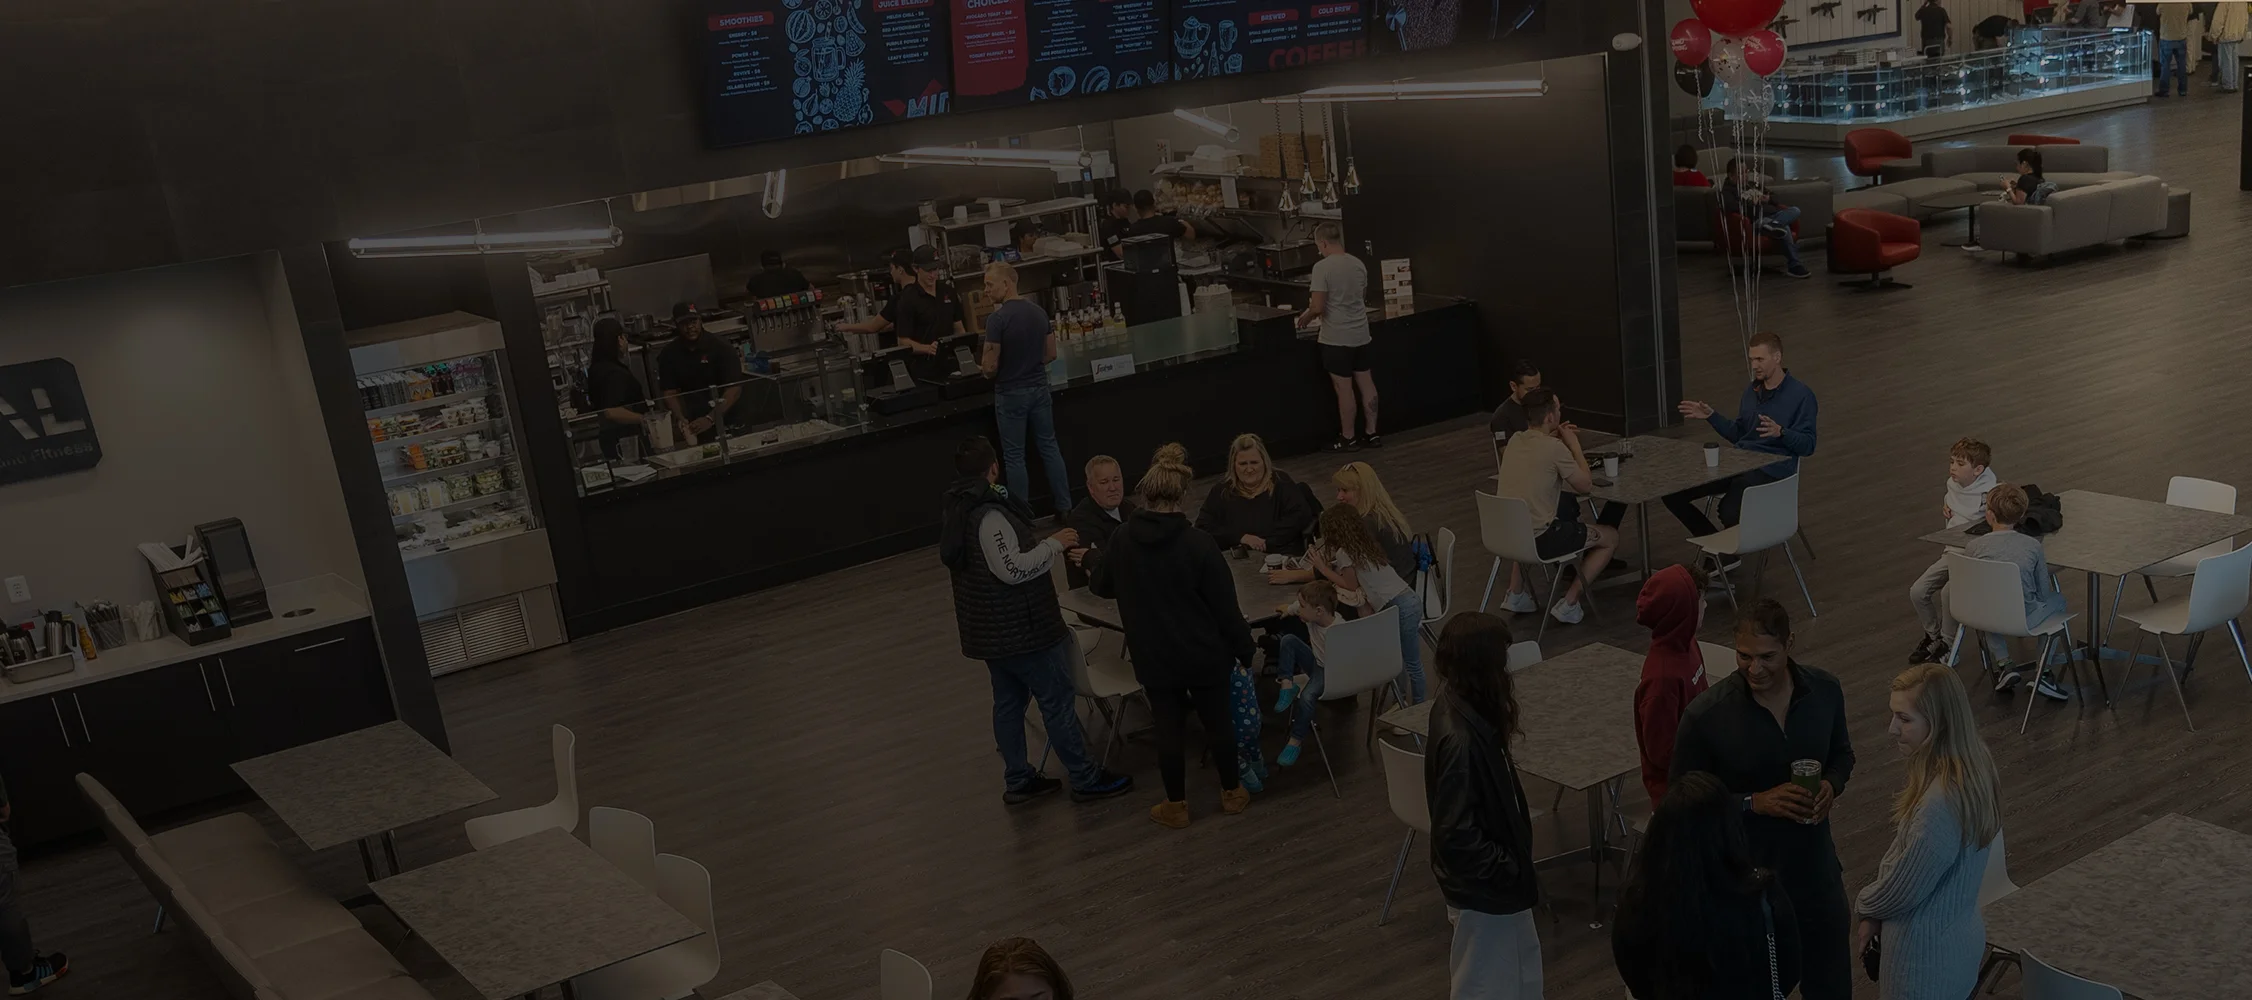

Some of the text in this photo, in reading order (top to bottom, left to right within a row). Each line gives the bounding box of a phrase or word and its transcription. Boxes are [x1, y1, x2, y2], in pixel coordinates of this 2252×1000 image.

[967, 0, 1009, 8] CHOIC
[719, 15, 764, 26] SMOOTHIES
[993, 530, 1008, 554] THE
